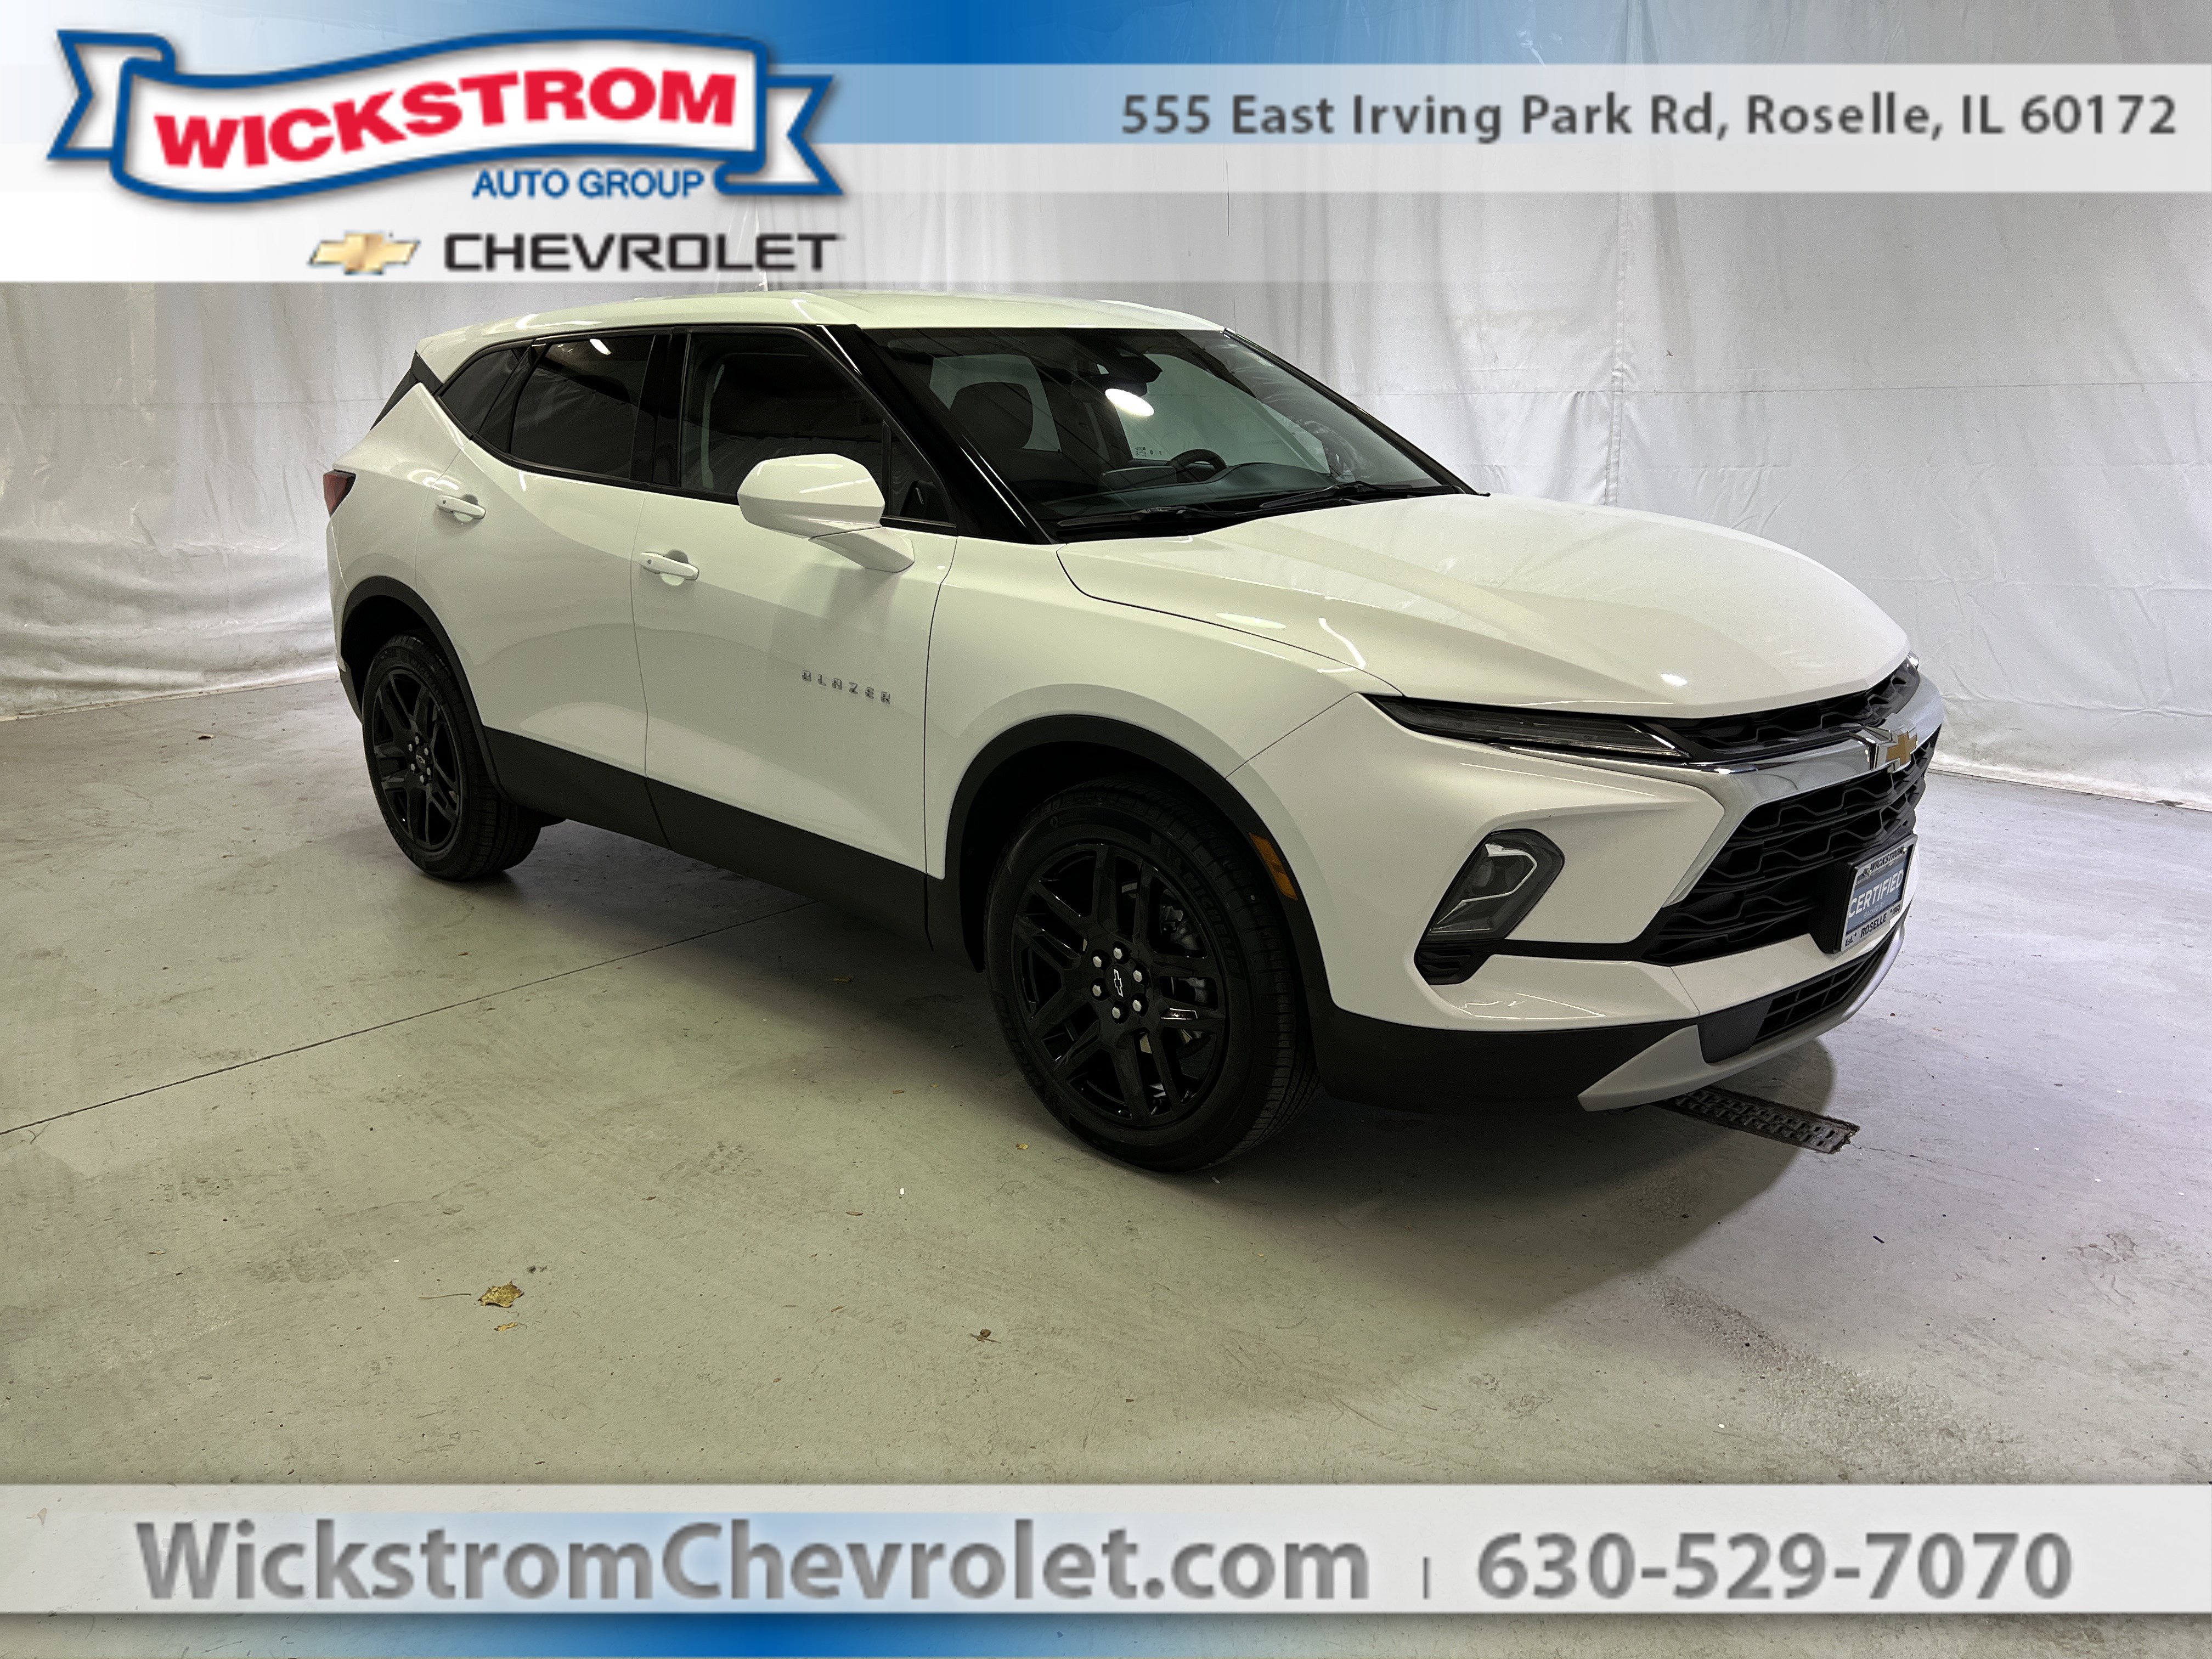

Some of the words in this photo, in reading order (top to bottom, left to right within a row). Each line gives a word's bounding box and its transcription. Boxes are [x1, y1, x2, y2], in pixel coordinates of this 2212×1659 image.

[801, 669, 891, 704] BLAZER
[1848, 869, 1904, 918] CERTIFIED
[1860, 912, 1887, 938] ROSELLE
